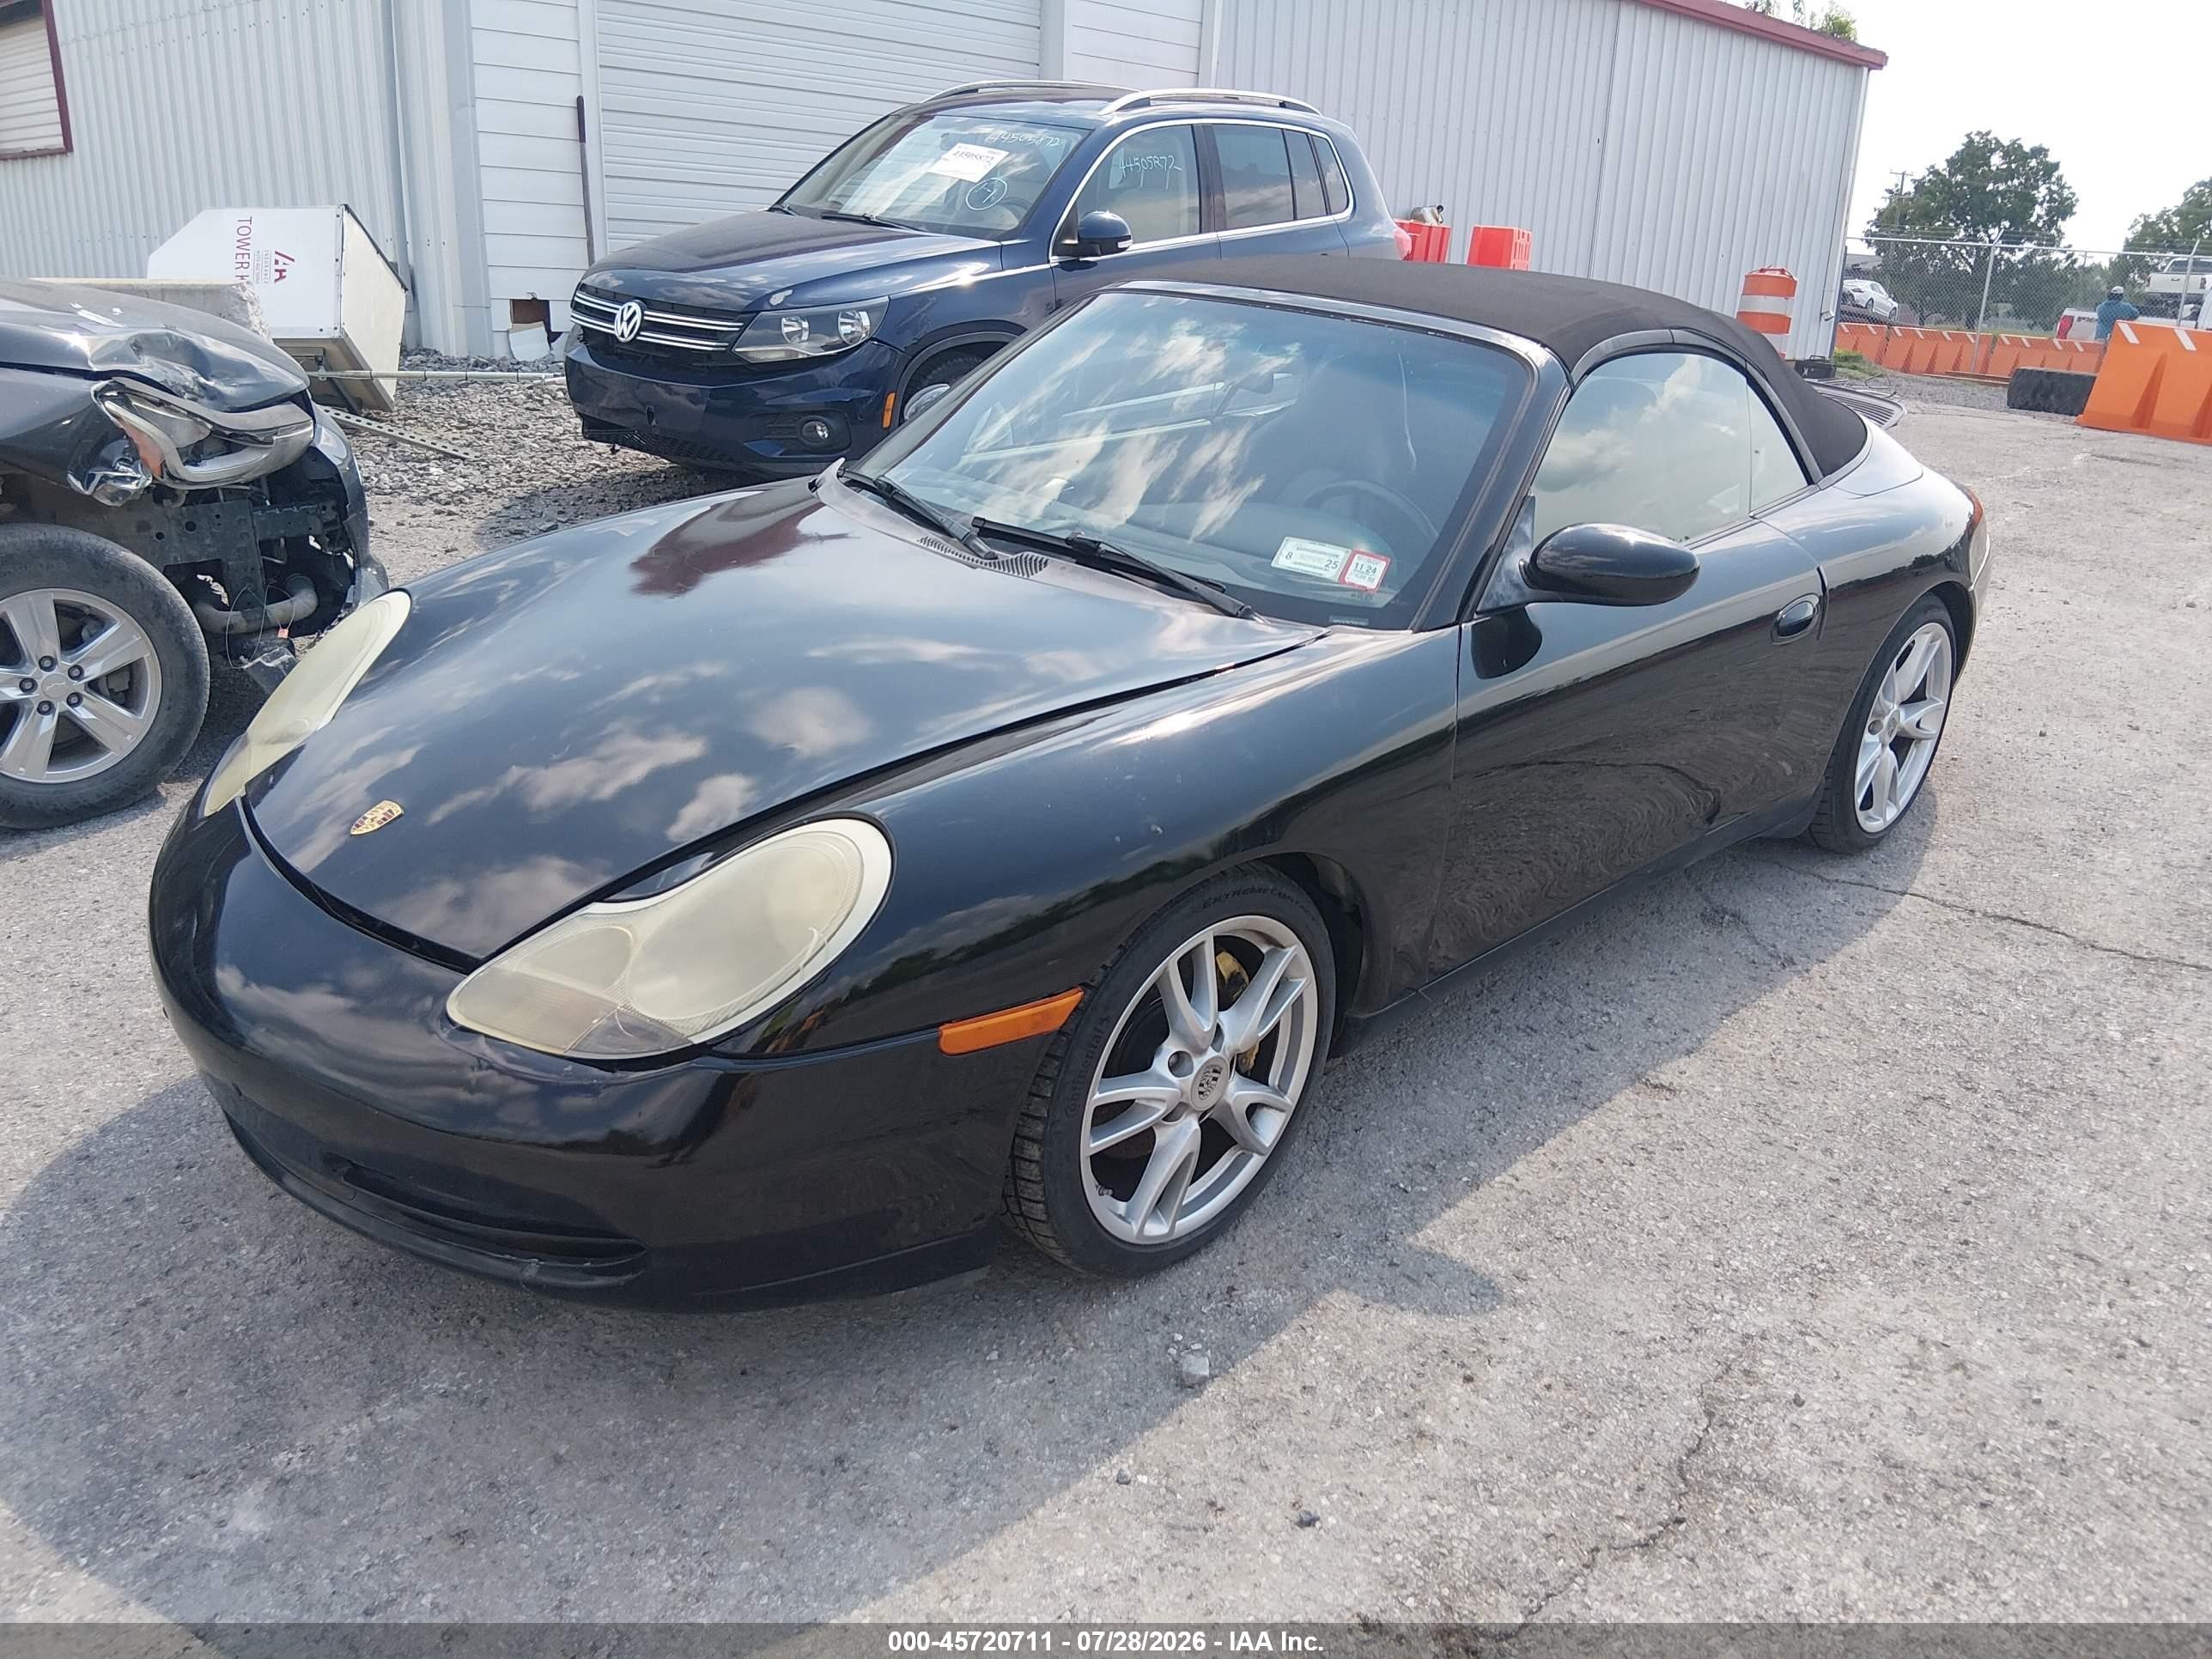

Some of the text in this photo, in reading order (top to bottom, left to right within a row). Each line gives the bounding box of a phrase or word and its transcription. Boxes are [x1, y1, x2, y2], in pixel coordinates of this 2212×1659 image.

[234, 216, 252, 270] TOWER
[1285, 551, 1293, 560] 8
[1324, 559, 1340, 569] 25
